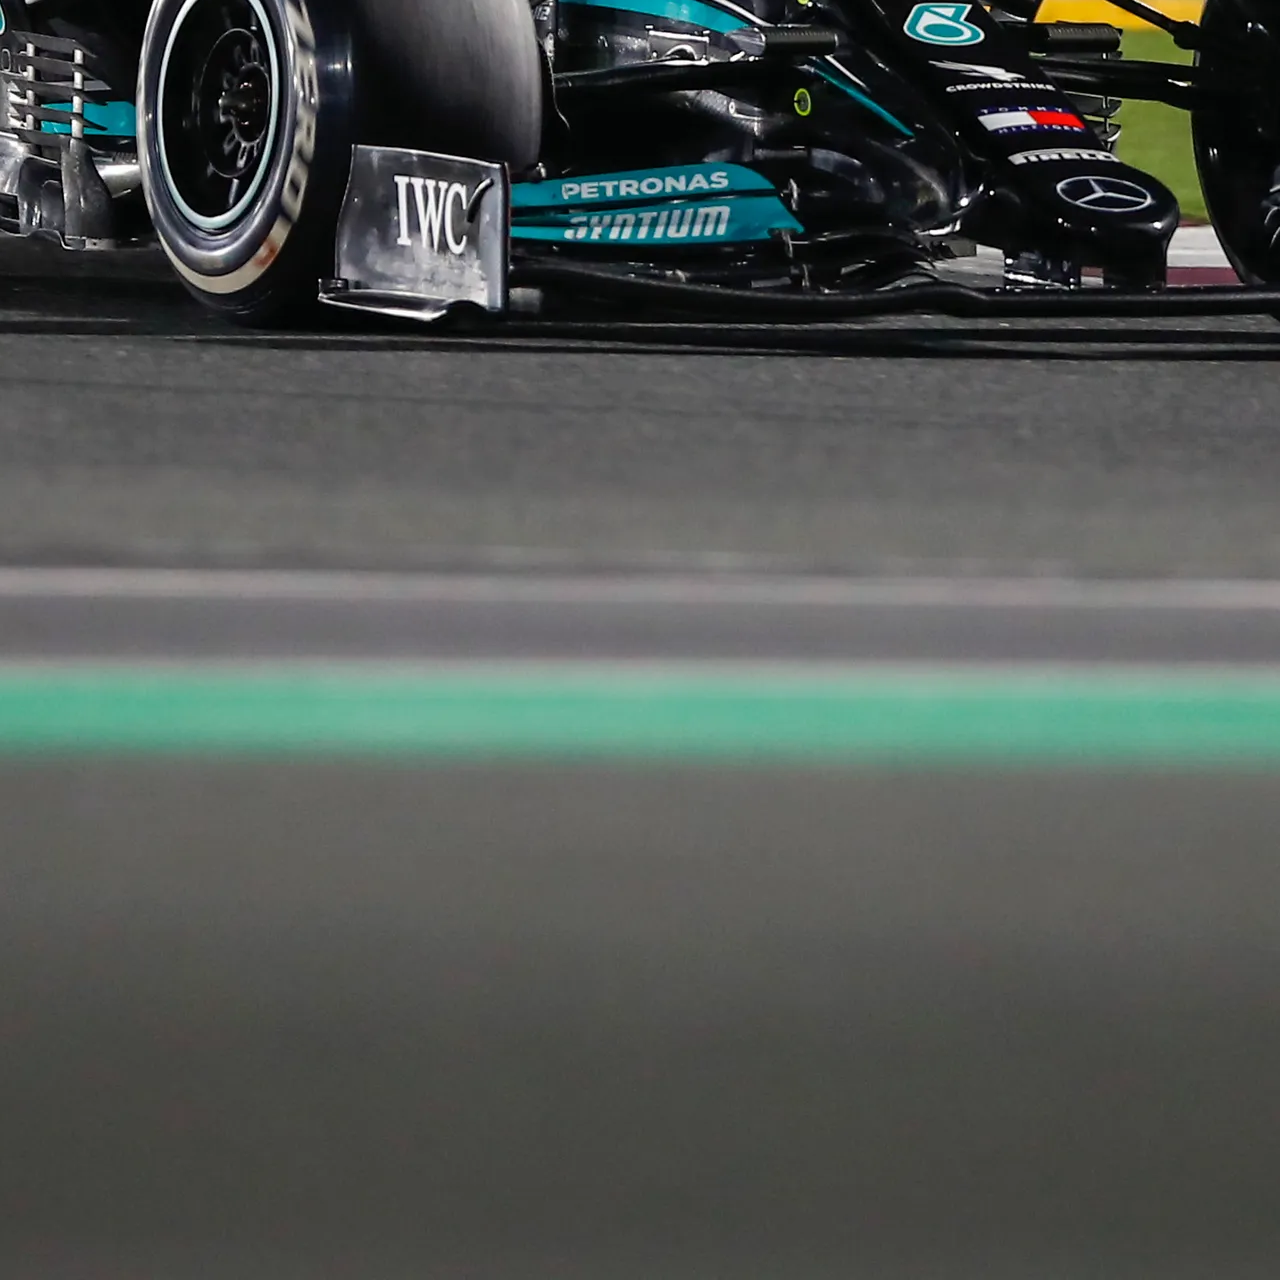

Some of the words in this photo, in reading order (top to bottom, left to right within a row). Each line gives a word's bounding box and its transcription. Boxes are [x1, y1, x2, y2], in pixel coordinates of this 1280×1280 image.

[946, 82, 1057, 93] CROWDSTRIKE
[980, 106, 1064, 115] TOMMY
[561, 171, 730, 201] PETRONAS
[393, 174, 468, 255] IWC
[563, 205, 731, 240] SYNTIUM
